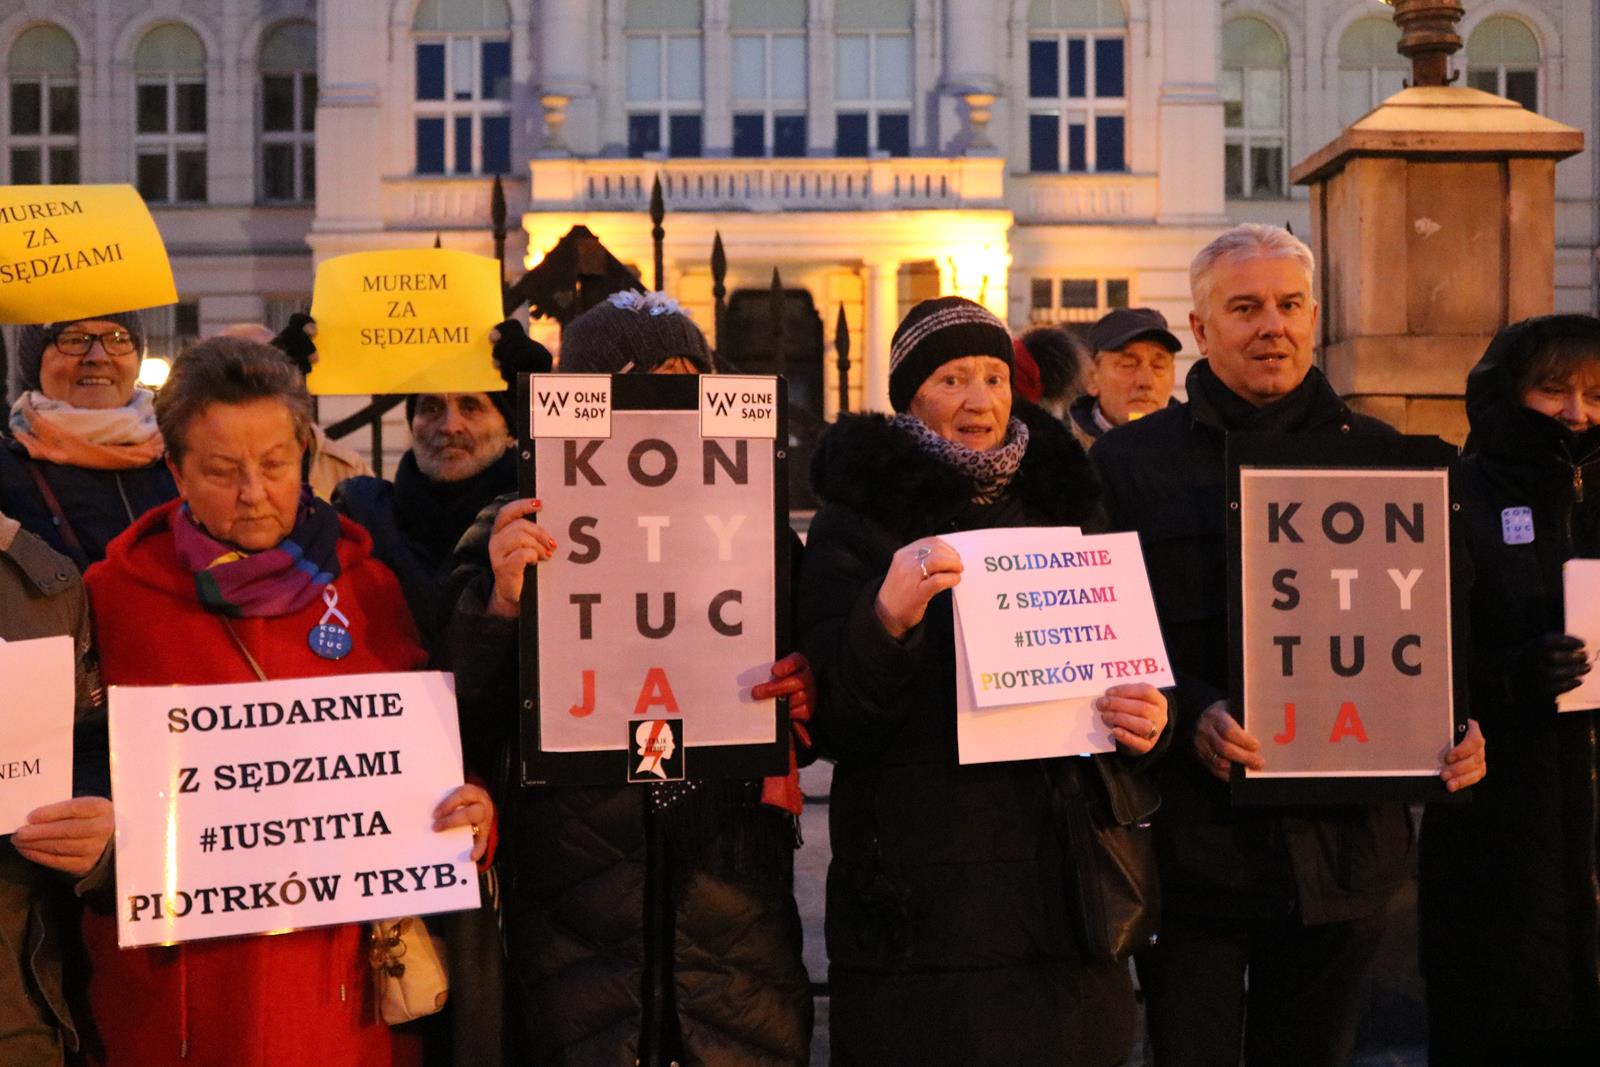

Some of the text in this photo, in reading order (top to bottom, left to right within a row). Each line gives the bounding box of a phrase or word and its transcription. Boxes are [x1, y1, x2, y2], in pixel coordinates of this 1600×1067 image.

[23, 228, 59, 249] ZA
[0, 243, 124, 284] SĘDZIAMI
[362, 273, 448, 292] MUREM
[388, 301, 416, 319] ZA
[360, 326, 470, 349] SĘDZIAMI
[574, 392, 607, 403] OLNE
[741, 393, 773, 404] OLNE
[574, 407, 606, 421] SĄDY
[741, 408, 773, 421] SĄDY
[984, 550, 1112, 573] SOLIDARNIE
[997, 586, 1118, 611] Z SĘDZIAMI
[1014, 624, 1118, 648] #IUSTITIA
[980, 658, 1165, 691] PIOTRKÓW TRYB.
[168, 693, 404, 734] SOLIDARNIE
[178, 750, 403, 794] Z SĘDZIAMI
[200, 811, 392, 853] #IUSTITIA
[128, 863, 469, 922] PIOTRKÓW TRYB.
